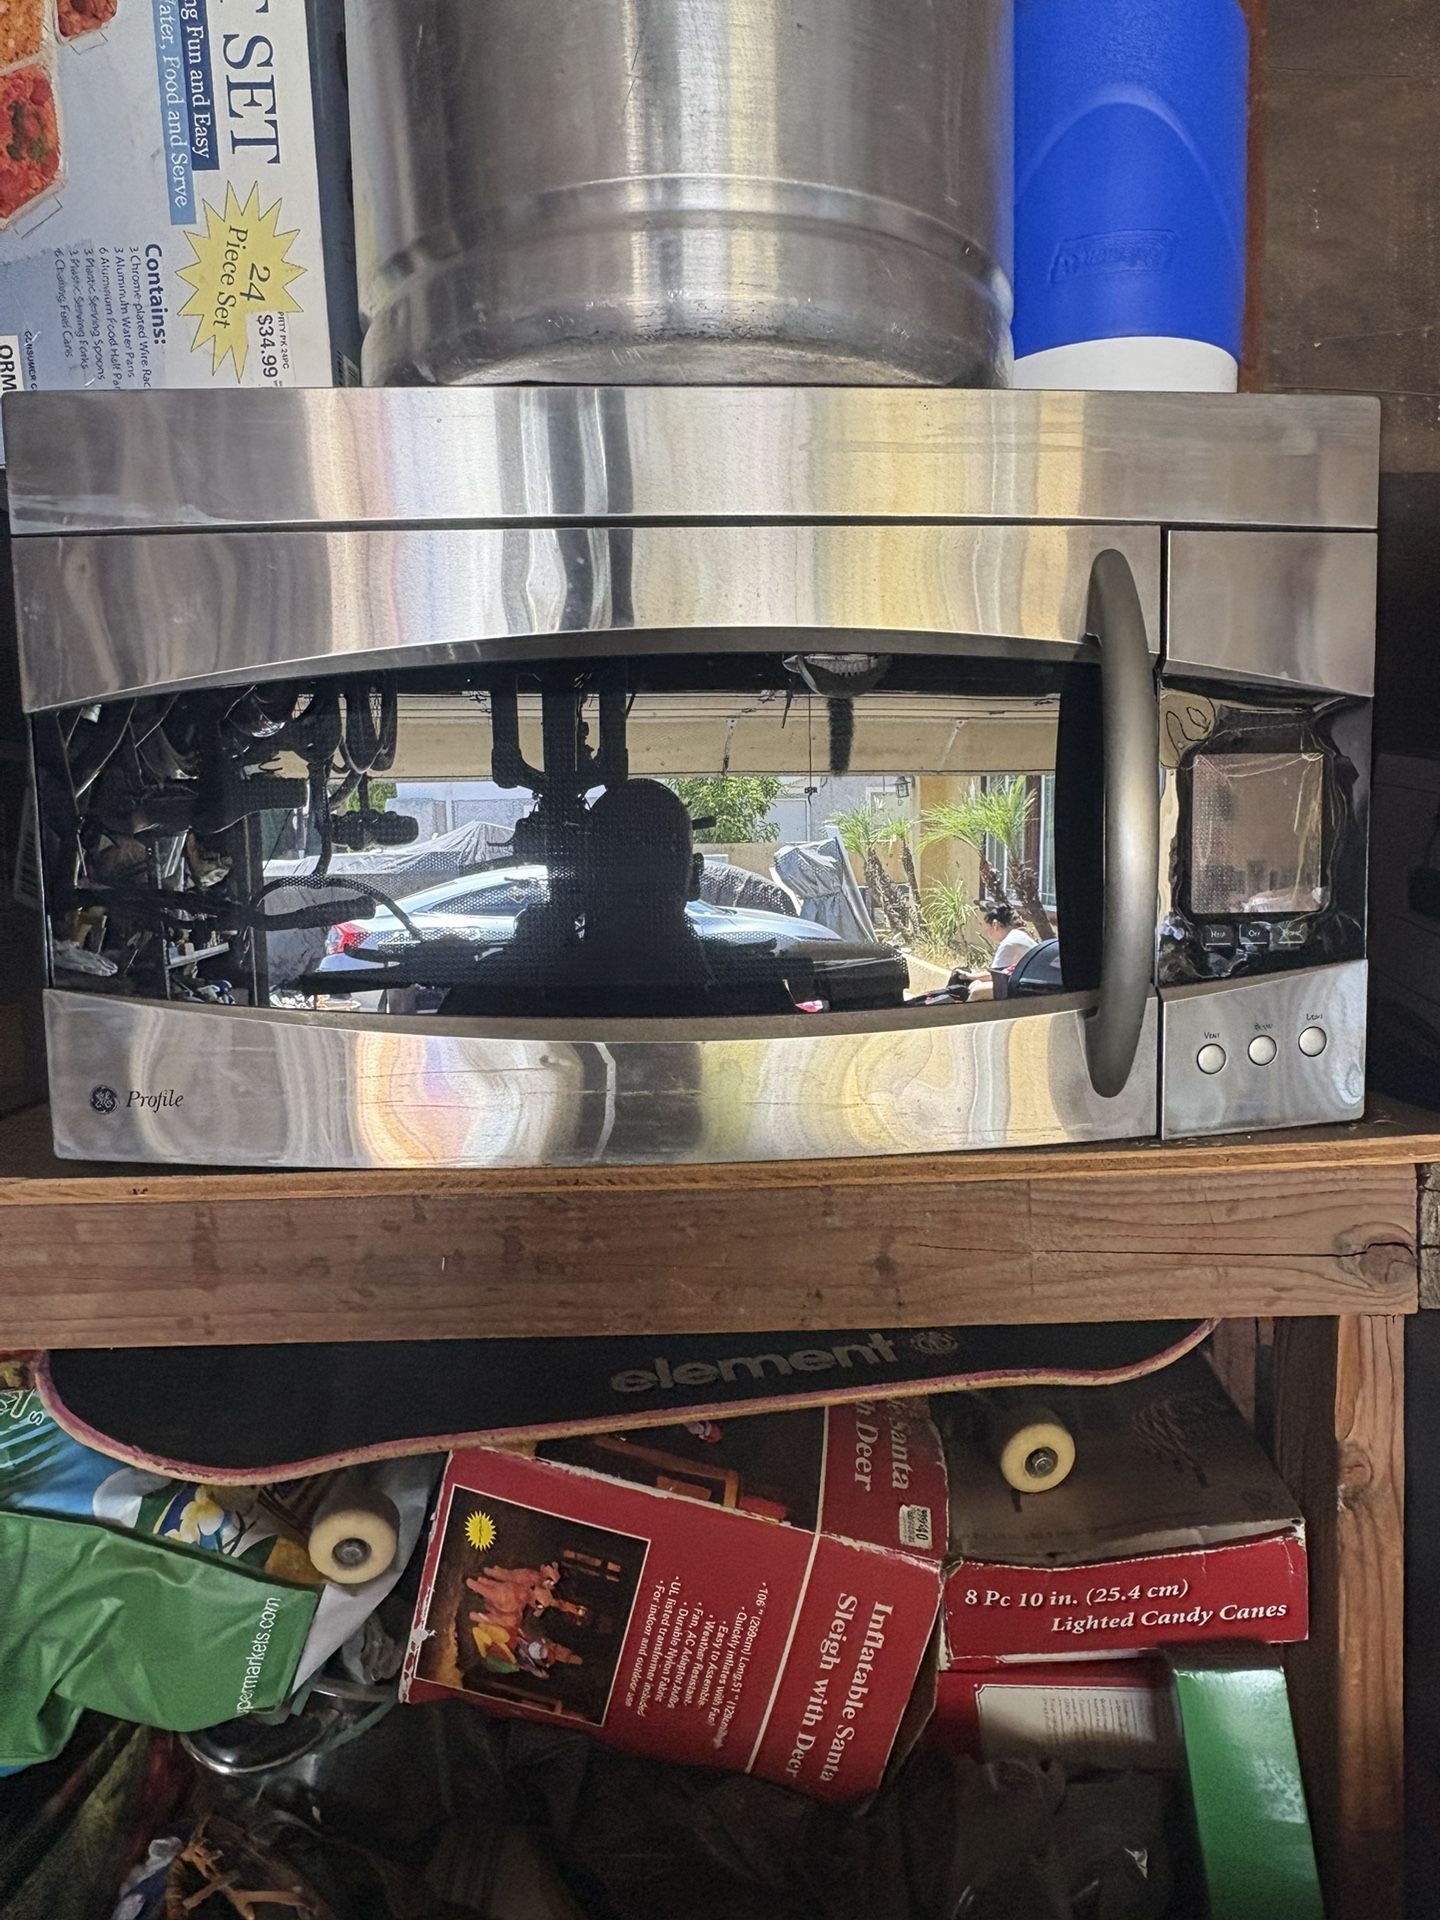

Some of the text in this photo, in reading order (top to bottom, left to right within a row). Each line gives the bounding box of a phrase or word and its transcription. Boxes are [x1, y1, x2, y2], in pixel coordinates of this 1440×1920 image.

[186, 25, 203, 65] Fun
[162, 55, 185, 105] Food
[190, 69, 210, 107] and
[223, 33, 281, 165] SET
[167, 111, 188, 146] and
[192, 112, 211, 159] Easy
[171, 153, 189, 208] Serve
[98, 247, 109, 255] 6
[70, 258, 81, 294] Plastic
[85, 257, 96, 293] Plastic
[100, 257, 113, 316] Aluminum
[115, 256, 128, 315] Aluminum
[145, 243, 169, 345] Contains:
[213, 225, 249, 329] Piece Set
[240, 262, 271, 302] 24
[73, 297, 85, 338] Serving
[88, 296, 100, 337] Serving
[106, 317, 119, 346] Food
[122, 316, 132, 350] Water
[24, 330, 37, 381] CONSUMER
[62, 330, 73, 359] Cans
[79, 339, 90, 370] Forks
[92, 339, 105, 381] Spoons
[140, 341, 151, 367] Wire
[256, 313, 279, 378] $34.99
[126, 352, 135, 378] Pans
[126, 1089, 185, 1113] Profile
[610, 1332, 899, 1393] element
[854, 1421, 879, 1492] Deer
[887, 1415, 914, 1490] Santa
[652, 1584, 665, 1602] For
[668, 1581, 681, 1595] UL
[964, 1578, 1190, 1607] 8 Pc 10 in. (25.4 cm)
[643, 1603, 660, 1635] indoor
[660, 1597, 676, 1626] listed
[688, 1607, 703, 1628] Fan,
[727, 1611, 747, 1649] Quickly
[1050, 1603, 1288, 1635] Lighted Candy Canes
[637, 1637, 649, 1656] and
[646, 1627, 667, 1681] transformer
[654, 1607, 688, 1702] Durable Nylon Fabric
[684, 1630, 696, 1646] AC
[695, 1620, 715, 1661] Weather
[697, 1625, 728, 1705] Easy to Assemble
[718, 1649, 735, 1684] inflates
[712, 1686, 724, 1705] with
[786, 1592, 858, 1779] Sleigh with Deer
[819, 1601, 894, 1782] Inflatable Santa
